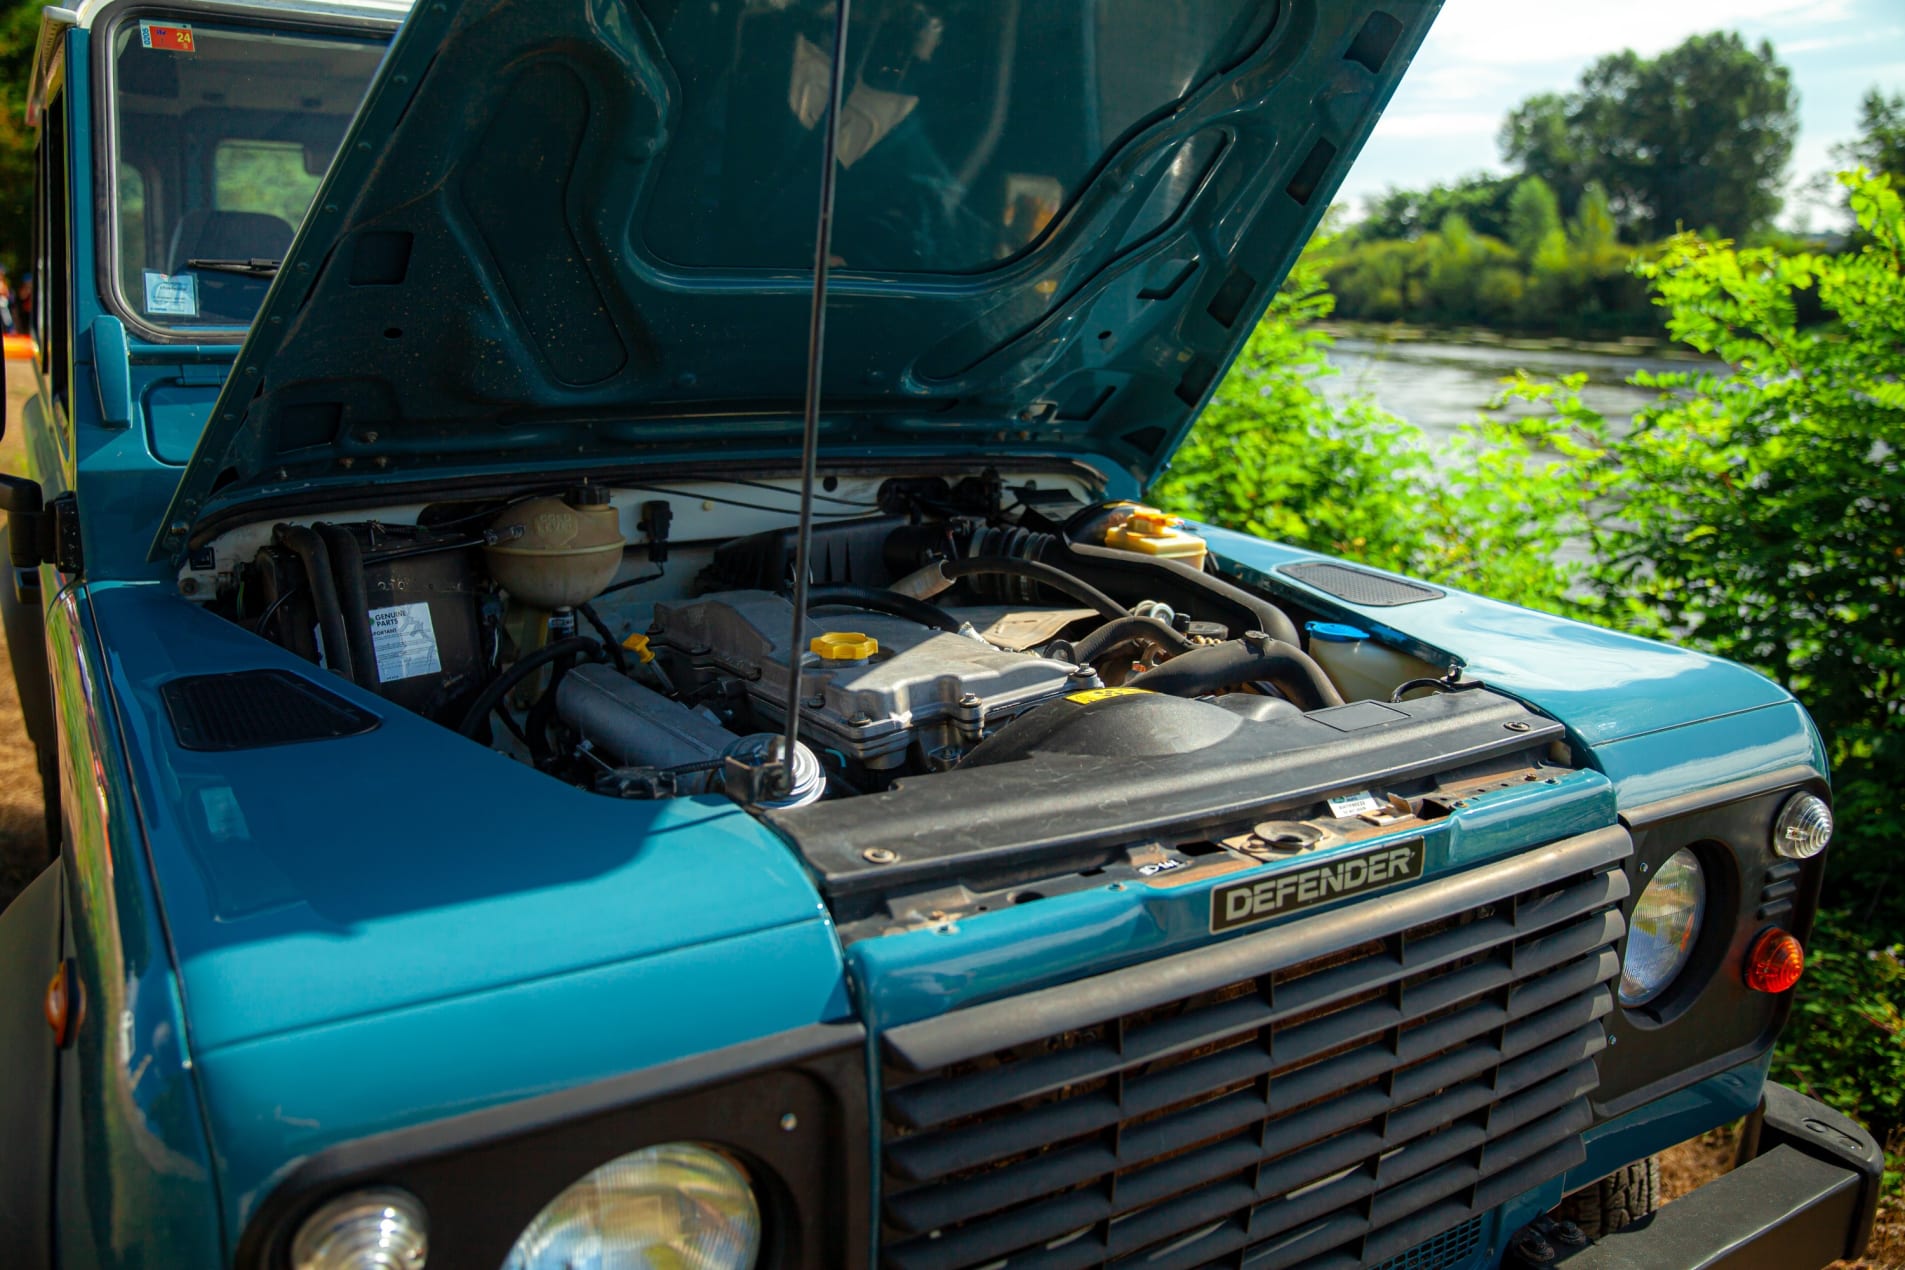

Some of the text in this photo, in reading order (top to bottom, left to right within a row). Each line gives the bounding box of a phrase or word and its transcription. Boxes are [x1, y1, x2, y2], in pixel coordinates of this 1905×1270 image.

[176, 32, 191, 43] 24
[374, 610, 407, 621] GENUINE
[376, 619, 399, 627] PARTS
[1226, 847, 1415, 921] DEFENDER
